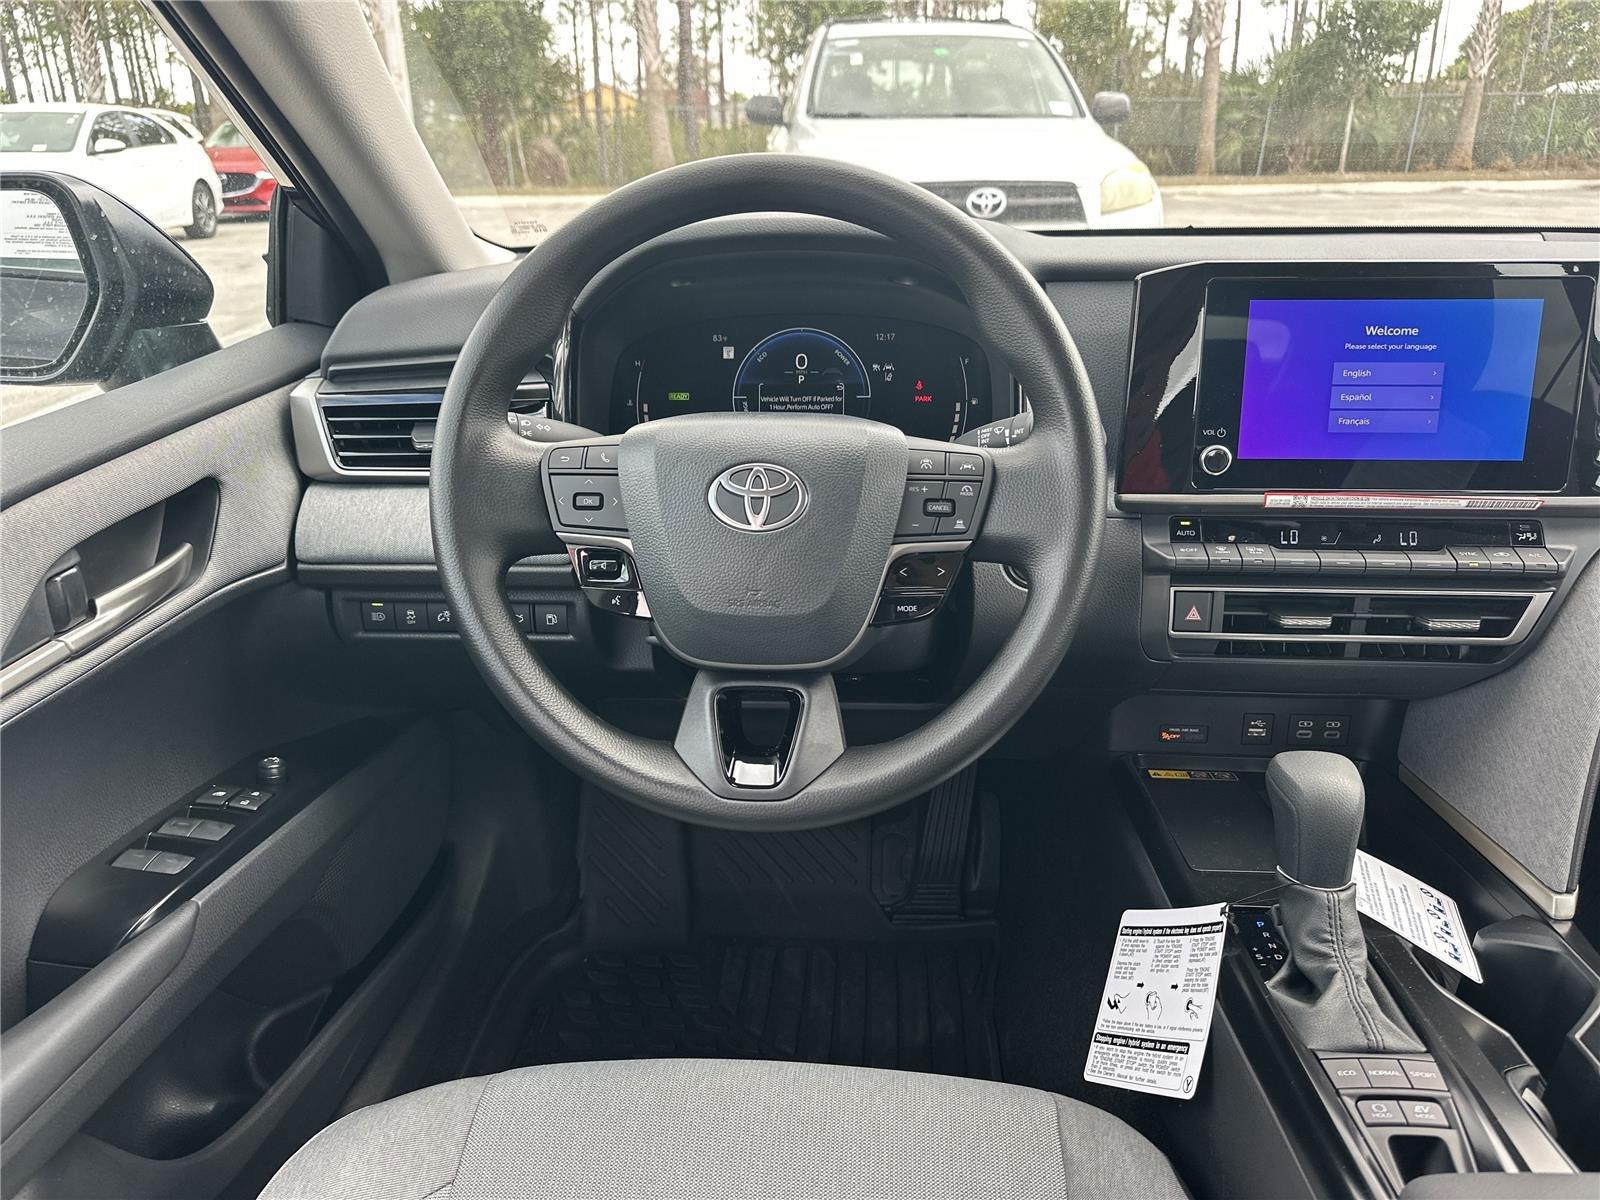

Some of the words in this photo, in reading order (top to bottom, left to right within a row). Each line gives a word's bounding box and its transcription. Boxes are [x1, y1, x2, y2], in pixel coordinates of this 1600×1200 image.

[1365, 326, 1419, 336] Welcome
[876, 333, 895, 341] 12:17
[1345, 342, 1366, 350] Please
[1368, 342, 1386, 350] select
[1404, 343, 1437, 352] language
[795, 353, 808, 370] 0
[834, 349, 850, 366] POWER
[1343, 369, 1372, 378] English
[799, 375, 805, 384] P
[1341, 392, 1372, 402] Español
[1338, 416, 1370, 426] Français
[1280, 530, 1299, 545] LO
[1400, 531, 1418, 546] LO
[1410, 1070, 1437, 1078] SPORT
[1414, 1105, 1430, 1113] EV
